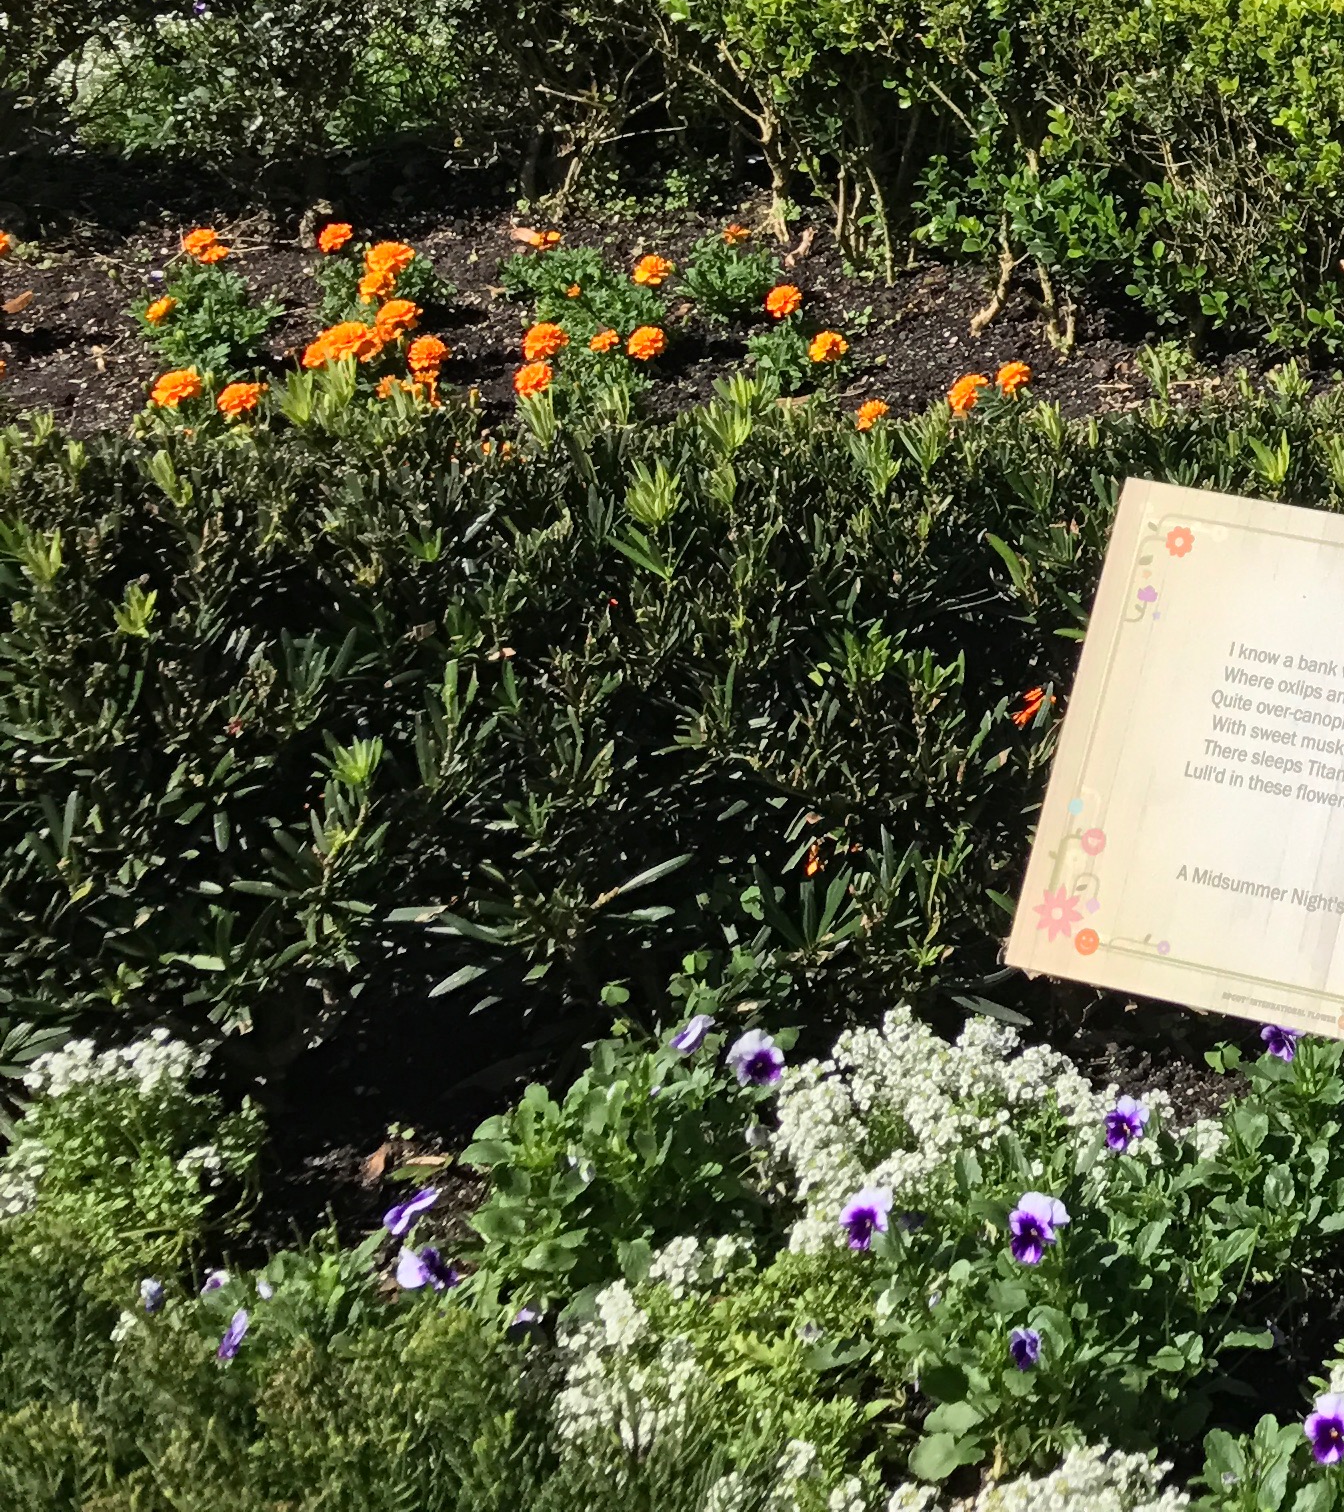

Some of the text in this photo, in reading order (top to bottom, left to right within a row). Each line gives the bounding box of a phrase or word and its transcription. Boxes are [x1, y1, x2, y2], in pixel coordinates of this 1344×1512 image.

[1229, 641, 1235, 657] I
[1238, 644, 1280, 666] know
[1283, 654, 1294, 669] a
[1297, 654, 1338, 677] bank
[1224, 665, 1274, 690] Where
[1278, 677, 1323, 700] oxlips
[1211, 689, 1253, 712] Quite
[1212, 715, 1247, 736] With
[1250, 726, 1297, 747] sweet
[1204, 739, 1247, 763] There
[1251, 749, 1303, 775] sleeps
[1184, 761, 1225, 785] Lull'd
[1229, 769, 1244, 788] in
[1248, 774, 1292, 798] these
[1175, 865, 1188, 881] A
[1192, 867, 1289, 902] Midsummer
[1250, 997, 1305, 1017] INTERNATIONAL
[1307, 1010, 1336, 1024] FLOWER
